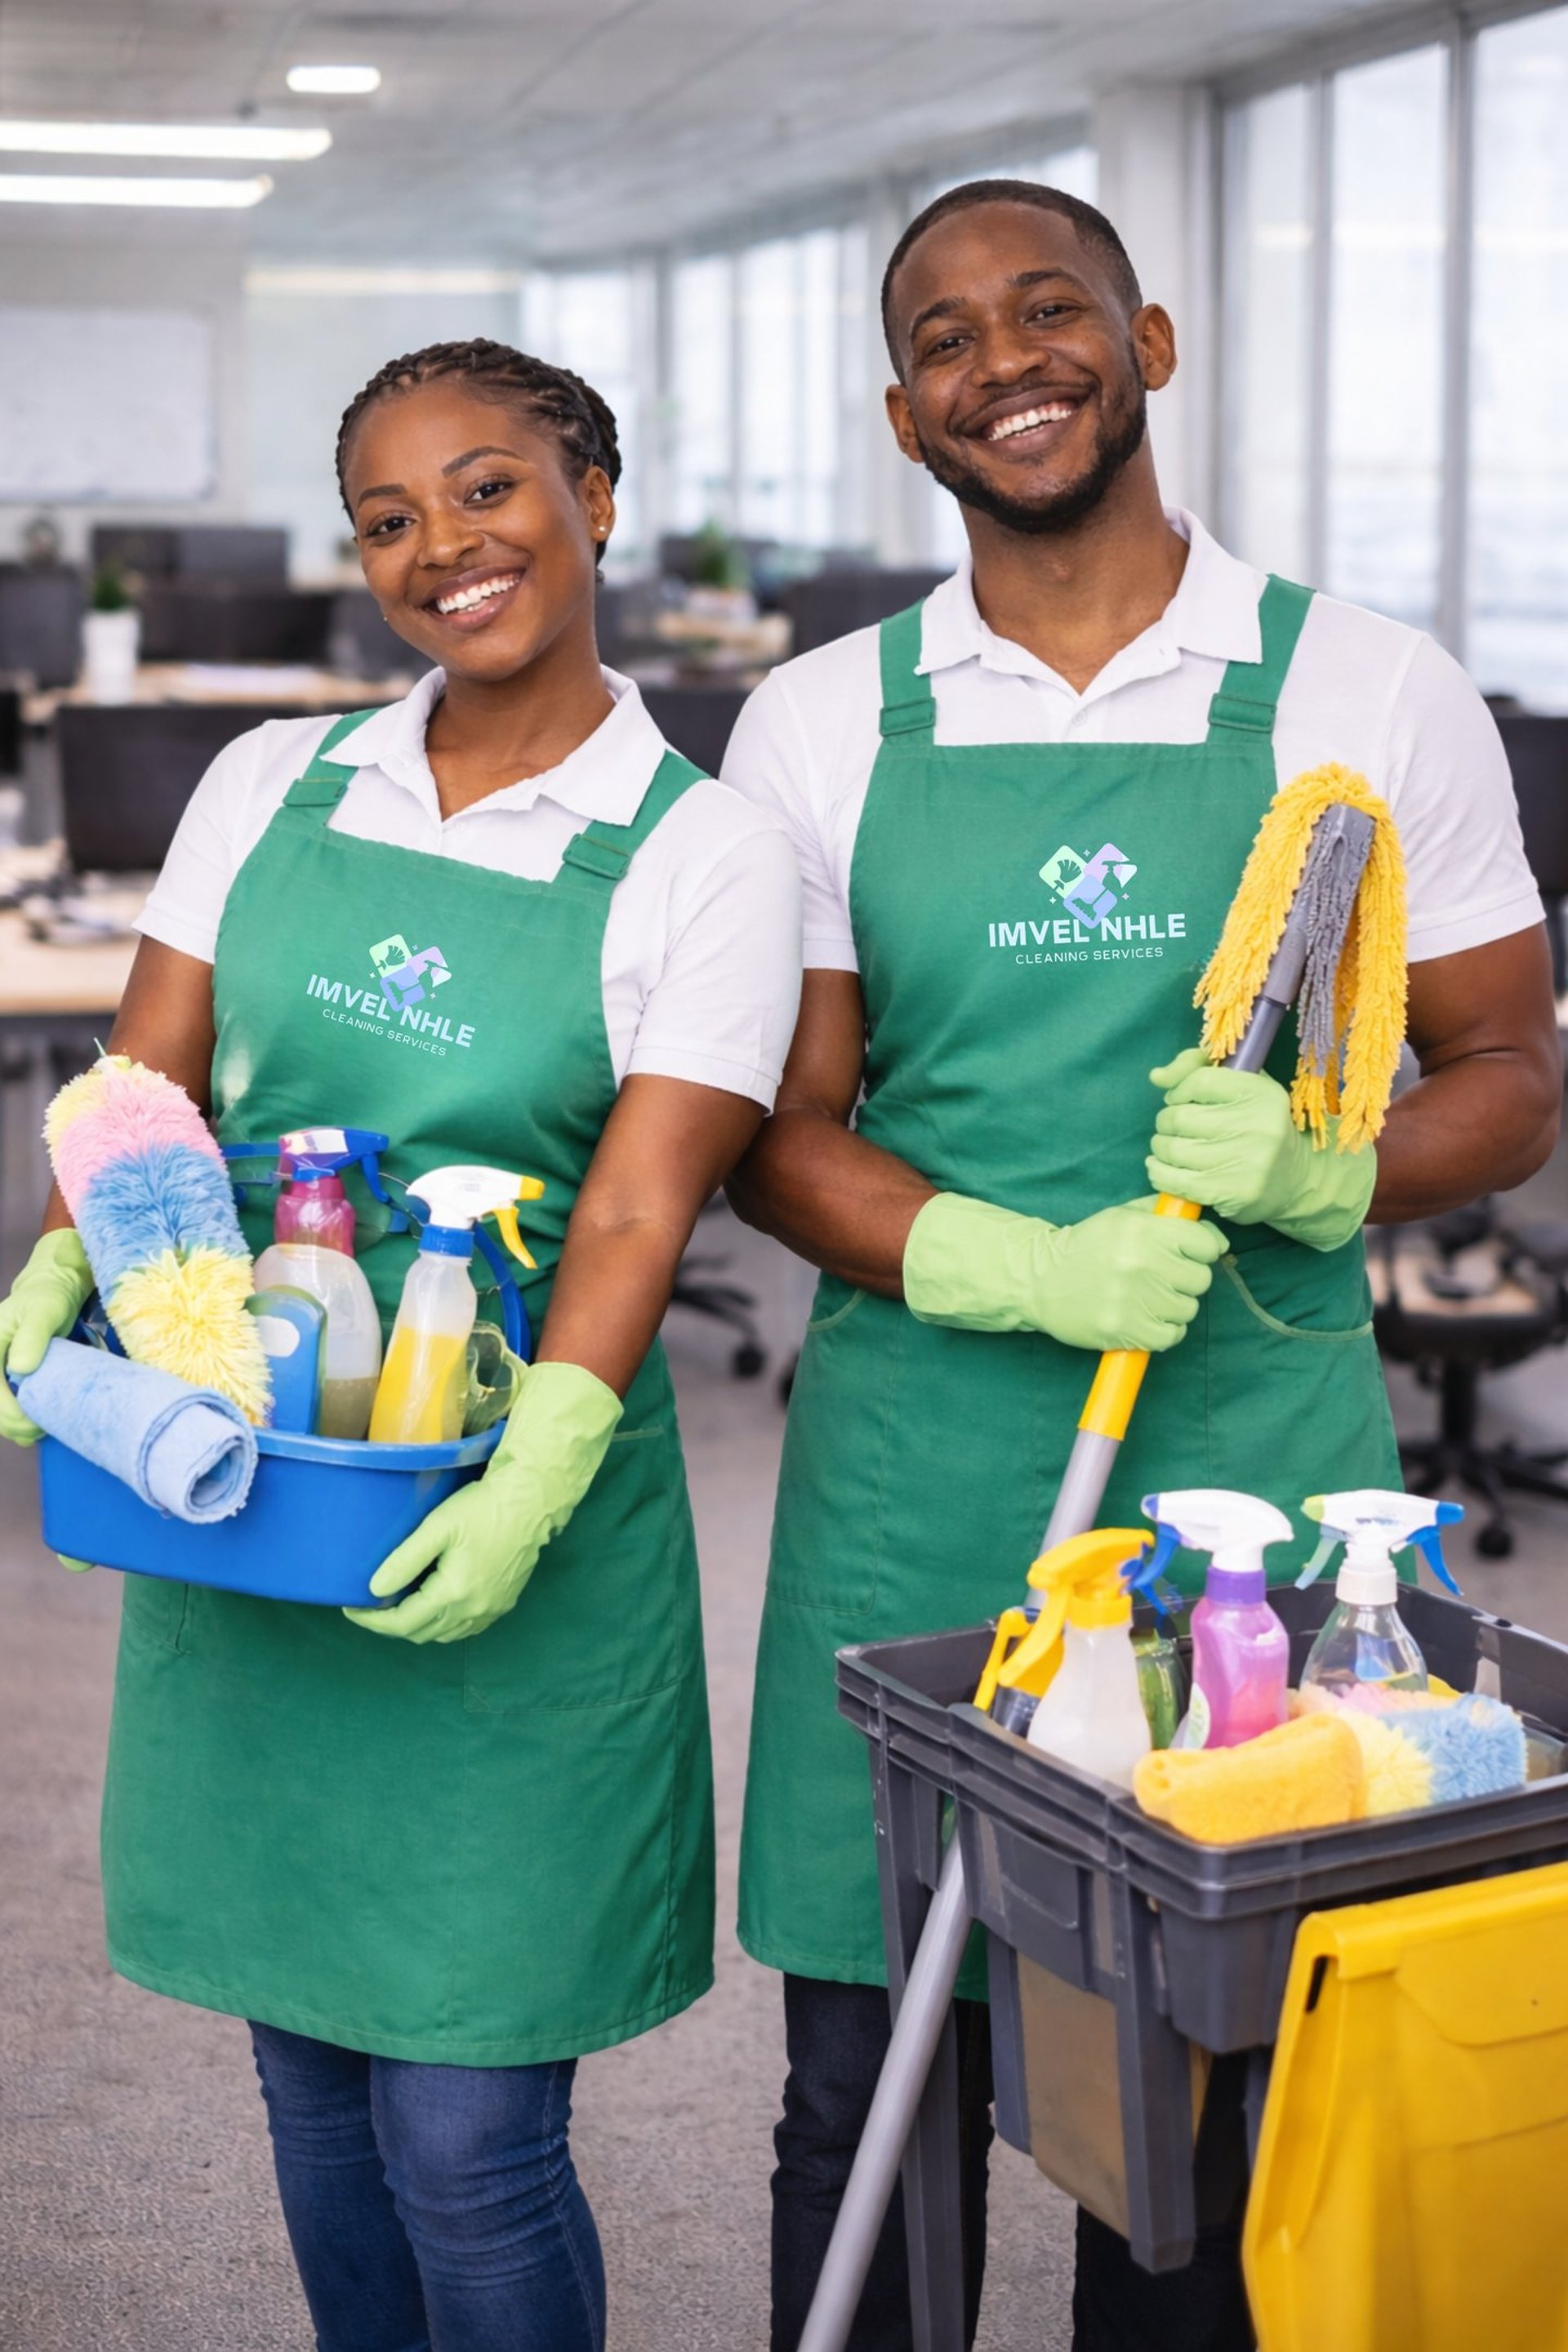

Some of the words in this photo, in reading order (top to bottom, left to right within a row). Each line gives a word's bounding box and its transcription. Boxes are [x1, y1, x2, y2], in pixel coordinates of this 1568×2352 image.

[988, 918, 1089, 947] IMVEL
[1101, 913, 1186, 942] NHLE
[1015, 951, 1089, 964] CLEANING
[1094, 947, 1164, 960] SERVICES
[306, 974, 390, 1021] IMVEL
[399, 1005, 475, 1048] NHLE
[323, 1009, 383, 1036] CLEANING
[387, 1030, 446, 1056] SERVICES
